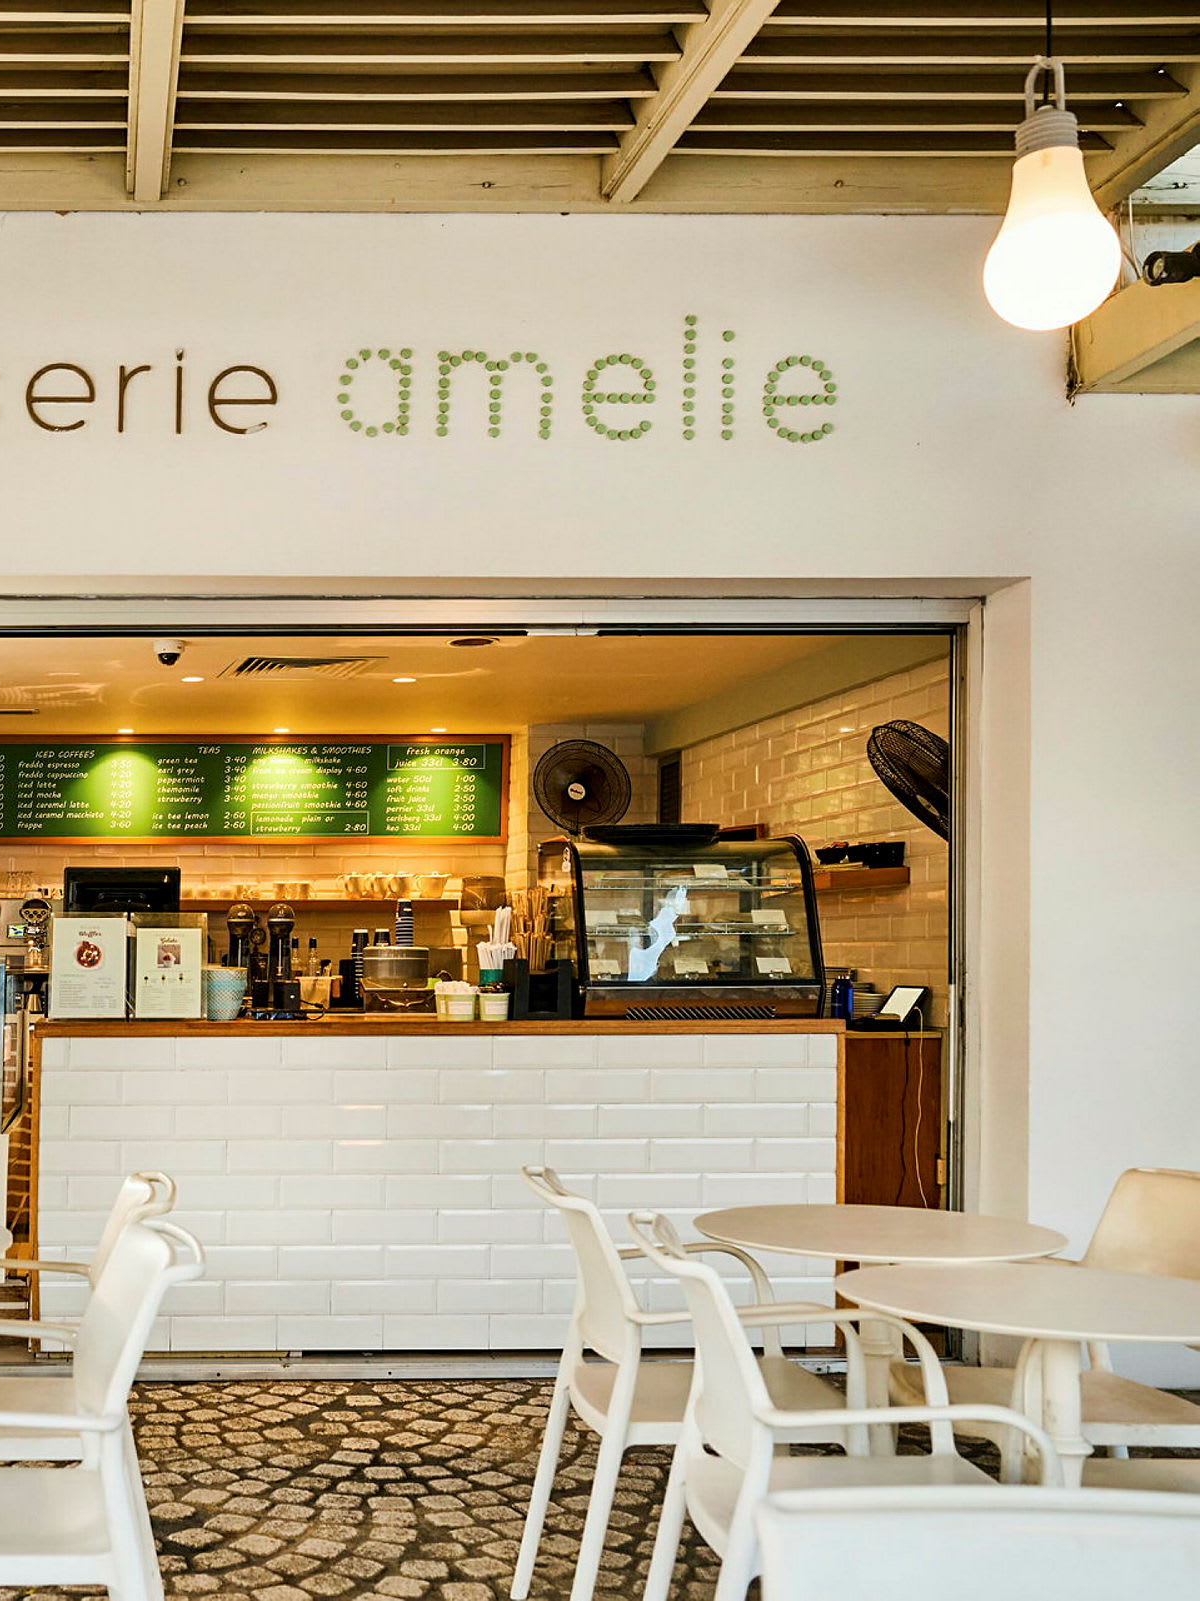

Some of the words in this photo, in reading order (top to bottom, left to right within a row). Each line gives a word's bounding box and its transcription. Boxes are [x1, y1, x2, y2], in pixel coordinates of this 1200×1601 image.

[336, 313, 838, 443] amelie
[58, 750, 95, 758] COFFEES
[198, 746, 221, 754] TEAS
[252, 747, 308, 755] MILKSHAKES
[322, 746, 372, 754] SMOOTHIES
[435, 748, 465, 756] orange
[395, 759, 417, 768] juice
[316, 767, 342, 775] display
[158, 795, 202, 804] strawberry
[408, 795, 426, 803] juice
[36, 801, 66, 809] caramel
[386, 806, 413, 814] perrier
[35, 811, 64, 819] caramel
[301, 816, 321, 824] plain
[184, 822, 208, 830] peach
[256, 825, 301, 833] strawberry
